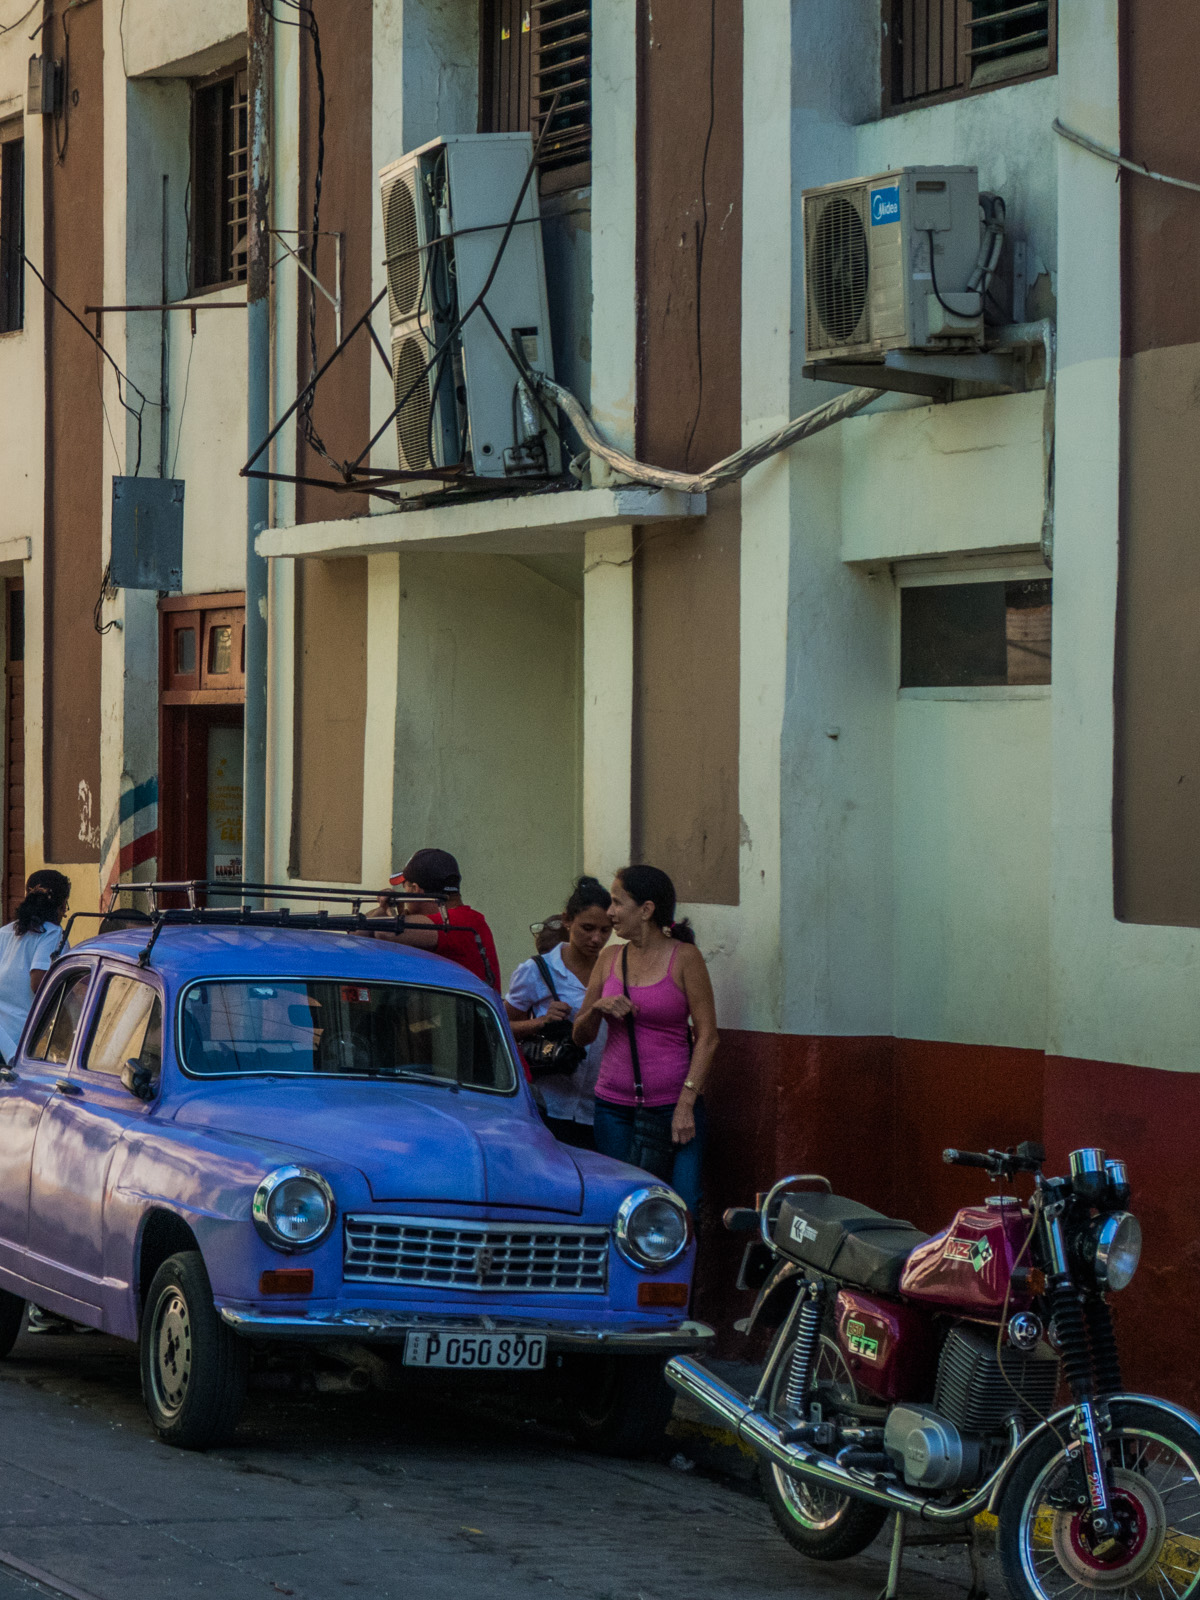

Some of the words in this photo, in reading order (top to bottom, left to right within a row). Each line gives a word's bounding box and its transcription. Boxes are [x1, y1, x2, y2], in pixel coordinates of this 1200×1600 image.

[878, 201, 898, 215] Midea
[946, 1240, 971, 1258] MZ
[850, 1336, 876, 1357] ETZ
